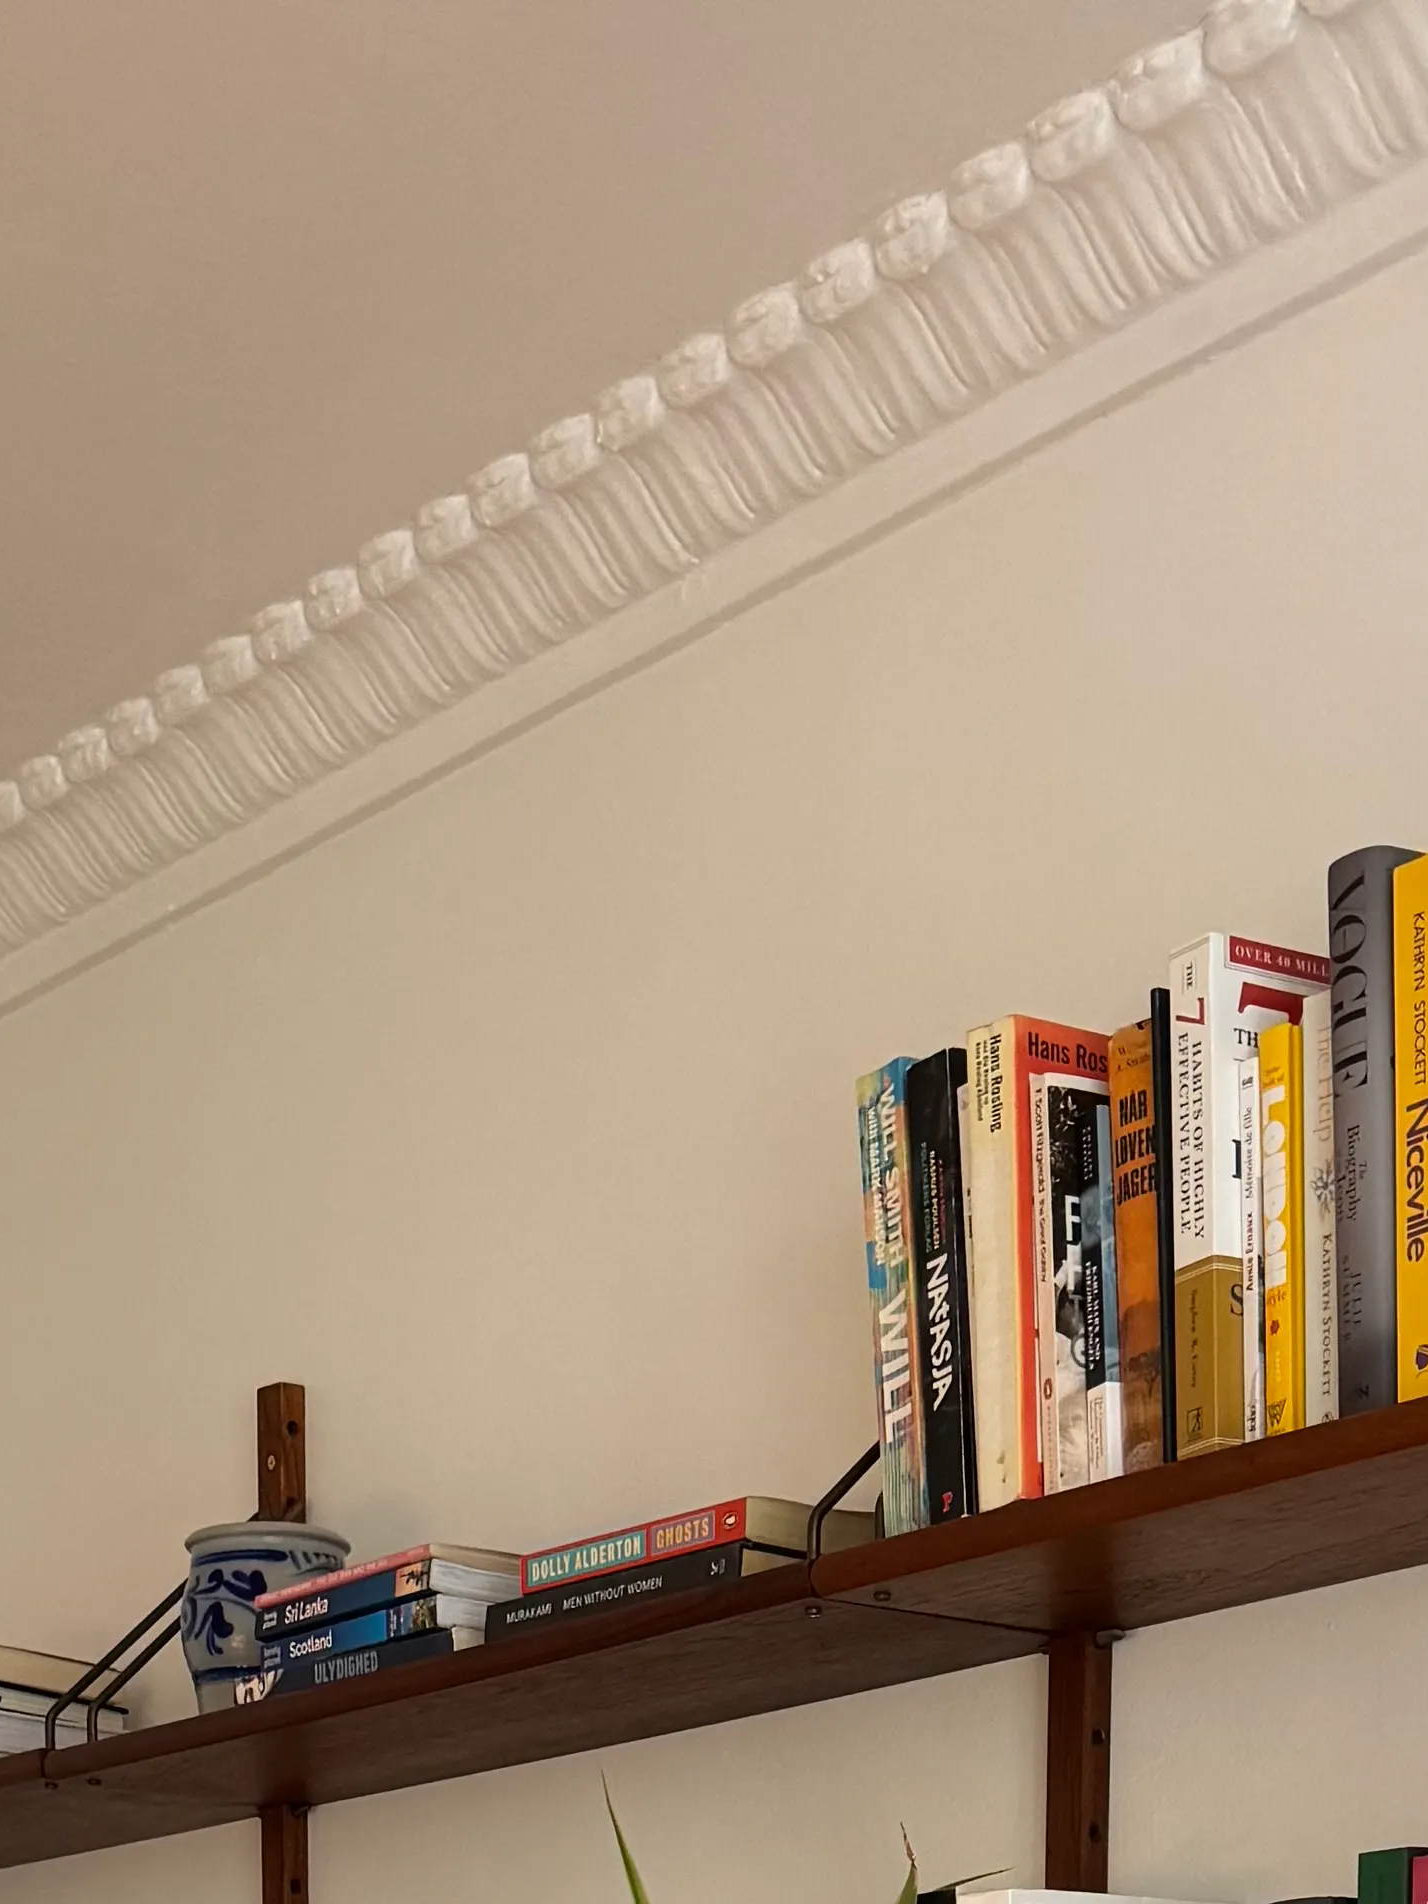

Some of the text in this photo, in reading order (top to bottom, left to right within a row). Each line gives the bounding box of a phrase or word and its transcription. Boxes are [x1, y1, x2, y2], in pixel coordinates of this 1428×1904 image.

[1329, 875, 1368, 1093] VOGUE
[1412, 911, 1427, 1086] KATHRYN STOCKETT
[1176, 997, 1206, 1026] 7
[1178, 1031, 1190, 1235] EFFECTIVE PEOPLE
[926, 1253, 954, 1411] NATASJA
[878, 1292, 912, 1443] WILL
[654, 1514, 711, 1553] GHOSTS
[531, 1534, 643, 1584] DOLLY ALDERTON
[506, 1601, 552, 1624] MURAKAMI
[289, 1629, 333, 1659] Scotland
[313, 1651, 379, 1685] ULYDIGHED
